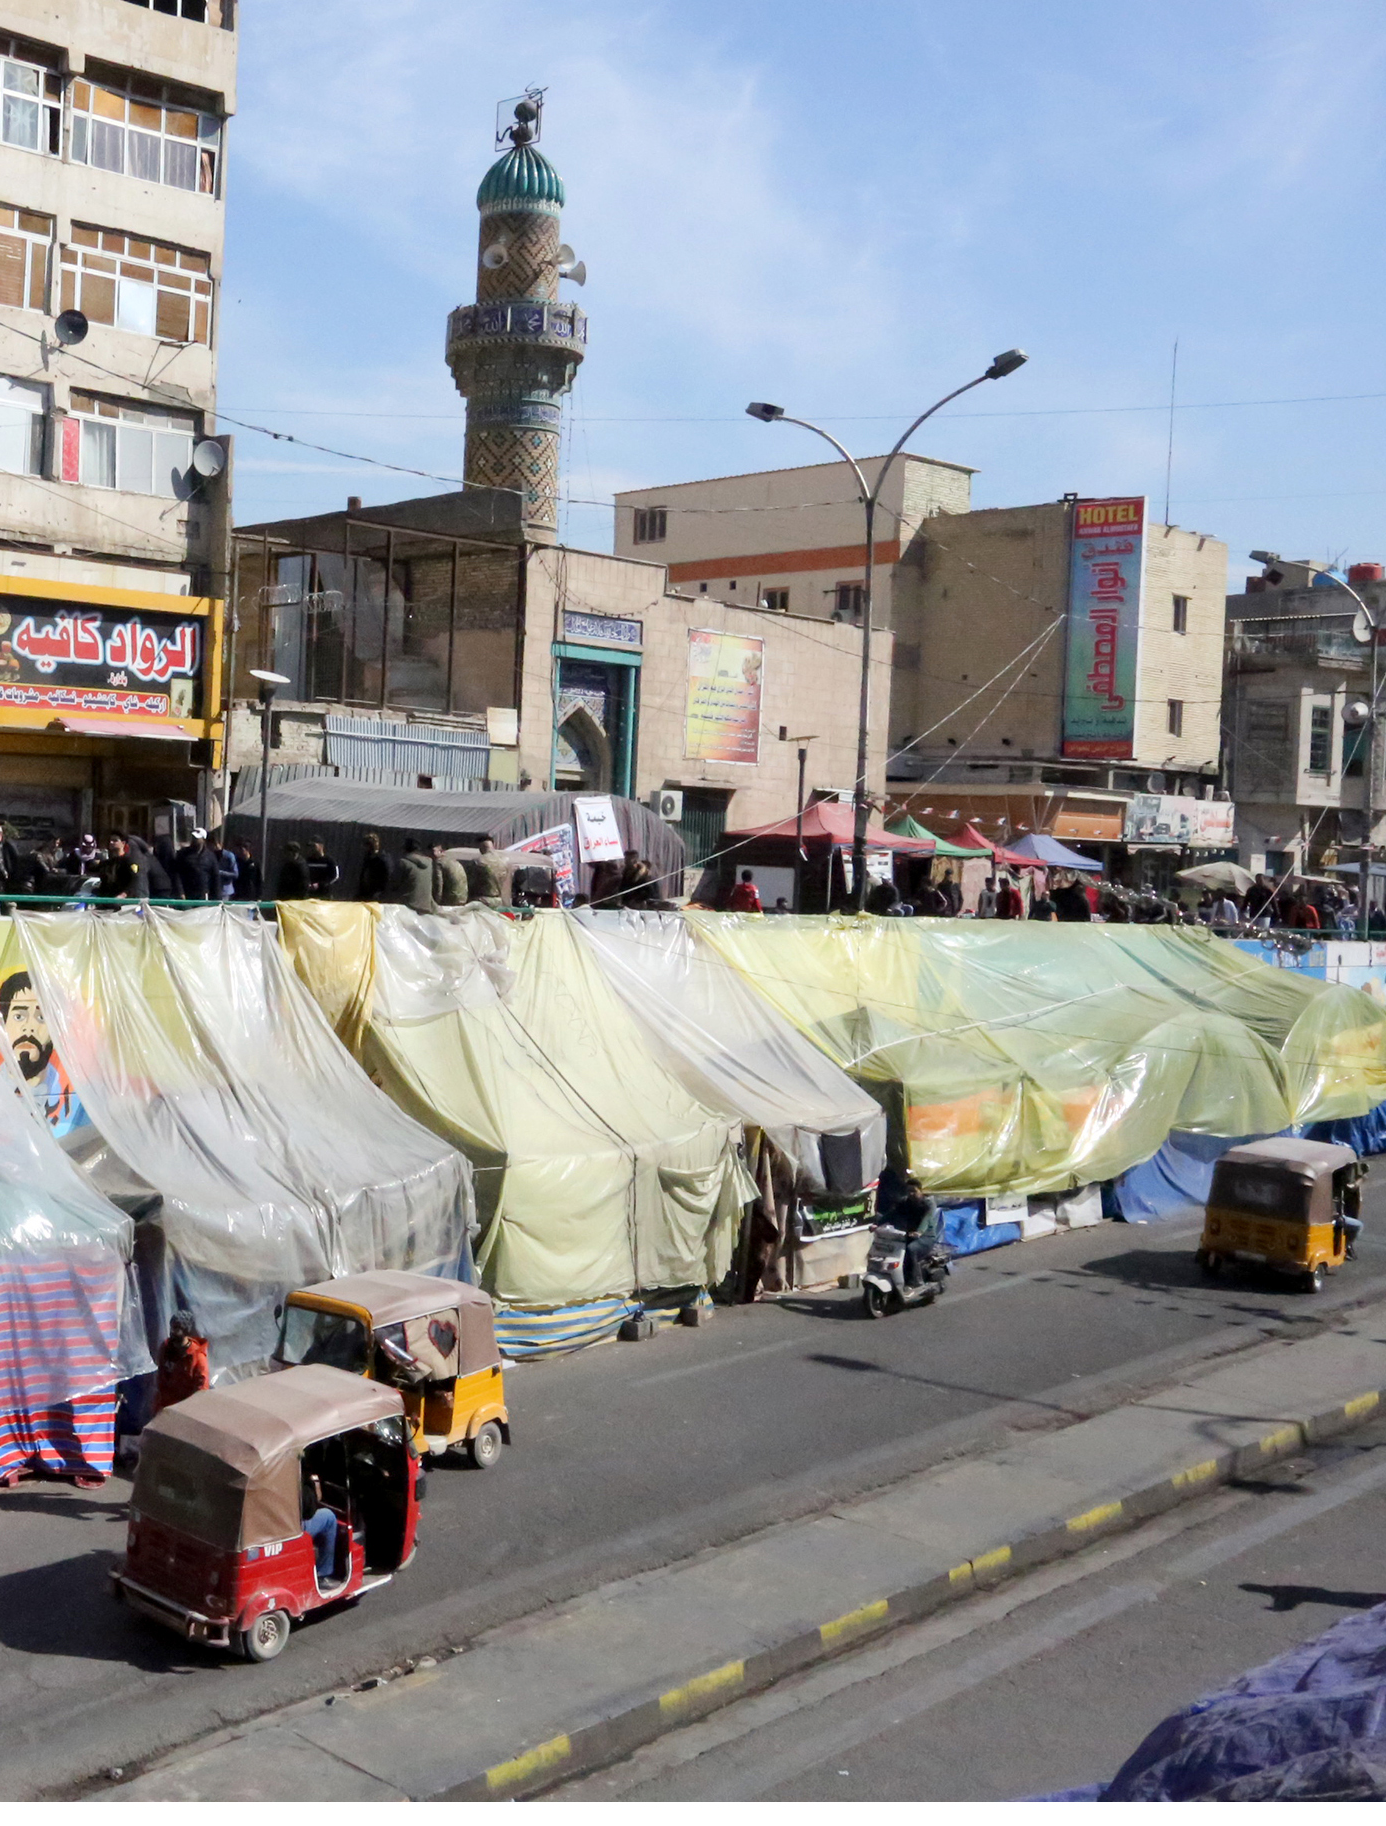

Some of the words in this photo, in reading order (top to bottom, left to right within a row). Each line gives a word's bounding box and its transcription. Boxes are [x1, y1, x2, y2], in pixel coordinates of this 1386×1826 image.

[1078, 505, 1139, 525] HOTEL
[1081, 539, 1134, 560] فندق
[1089, 561, 1127, 602] انوار
[14, 612, 103, 672] كافيه
[106, 617, 198, 682] الرواد
[122, 695, 139, 714] شاي
